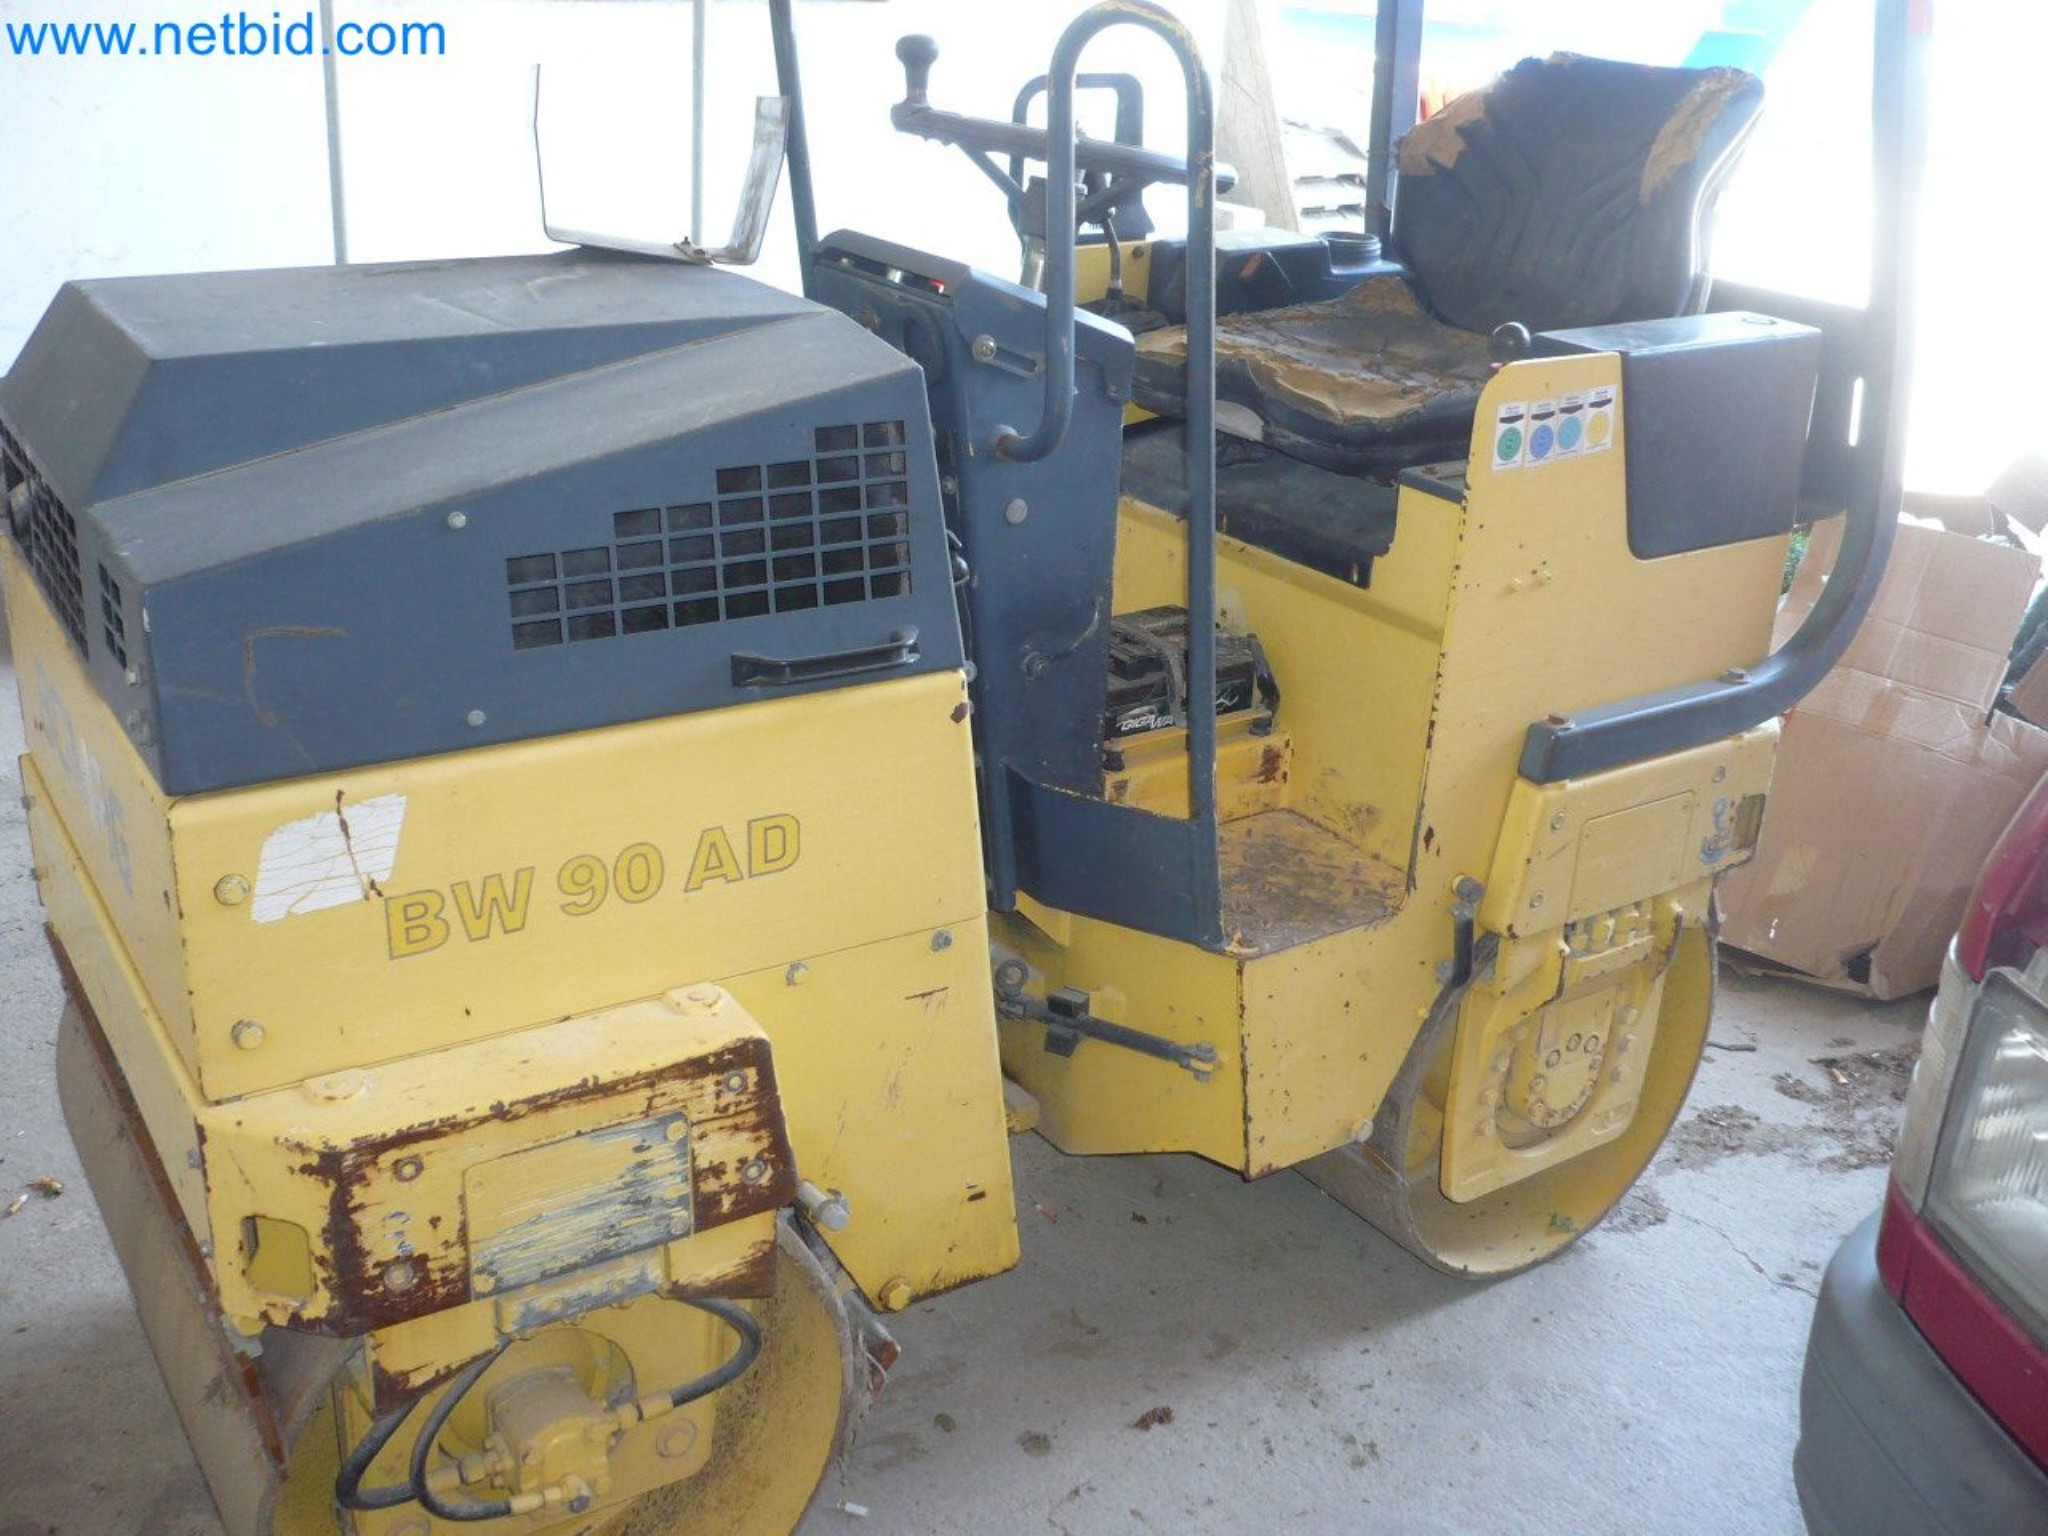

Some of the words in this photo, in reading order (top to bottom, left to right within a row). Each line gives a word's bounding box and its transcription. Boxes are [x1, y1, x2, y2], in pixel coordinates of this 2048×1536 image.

[383, 865, 536, 961] BW
[556, 841, 665, 917] 90
[683, 813, 801, 894] AD
